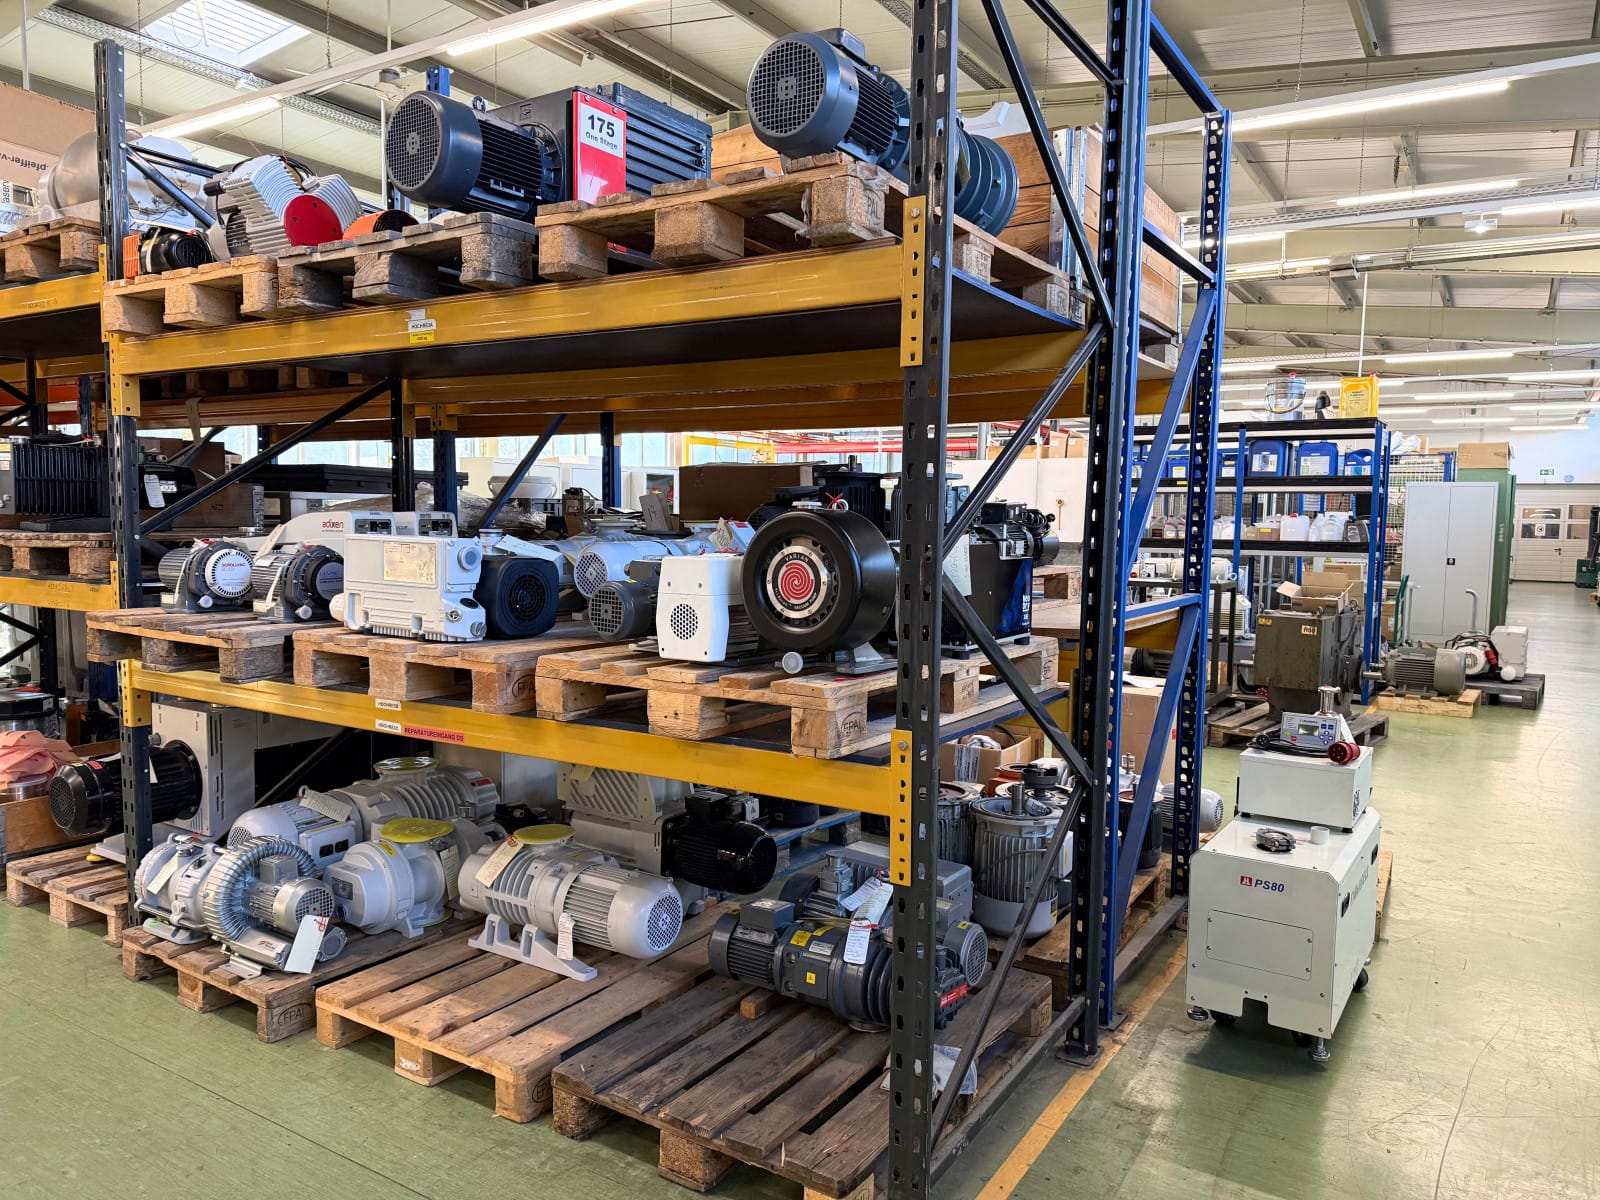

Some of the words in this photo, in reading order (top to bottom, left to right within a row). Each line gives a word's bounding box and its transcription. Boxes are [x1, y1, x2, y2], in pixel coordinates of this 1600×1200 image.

[587, 113, 615, 138] 175
[585, 131, 599, 142] One
[599, 136, 618, 150] Stage
[783, 553, 809, 563] VARIAN
[404, 727, 456, 741] REPARATUREINGANG
[1254, 878, 1285, 893] PS80
